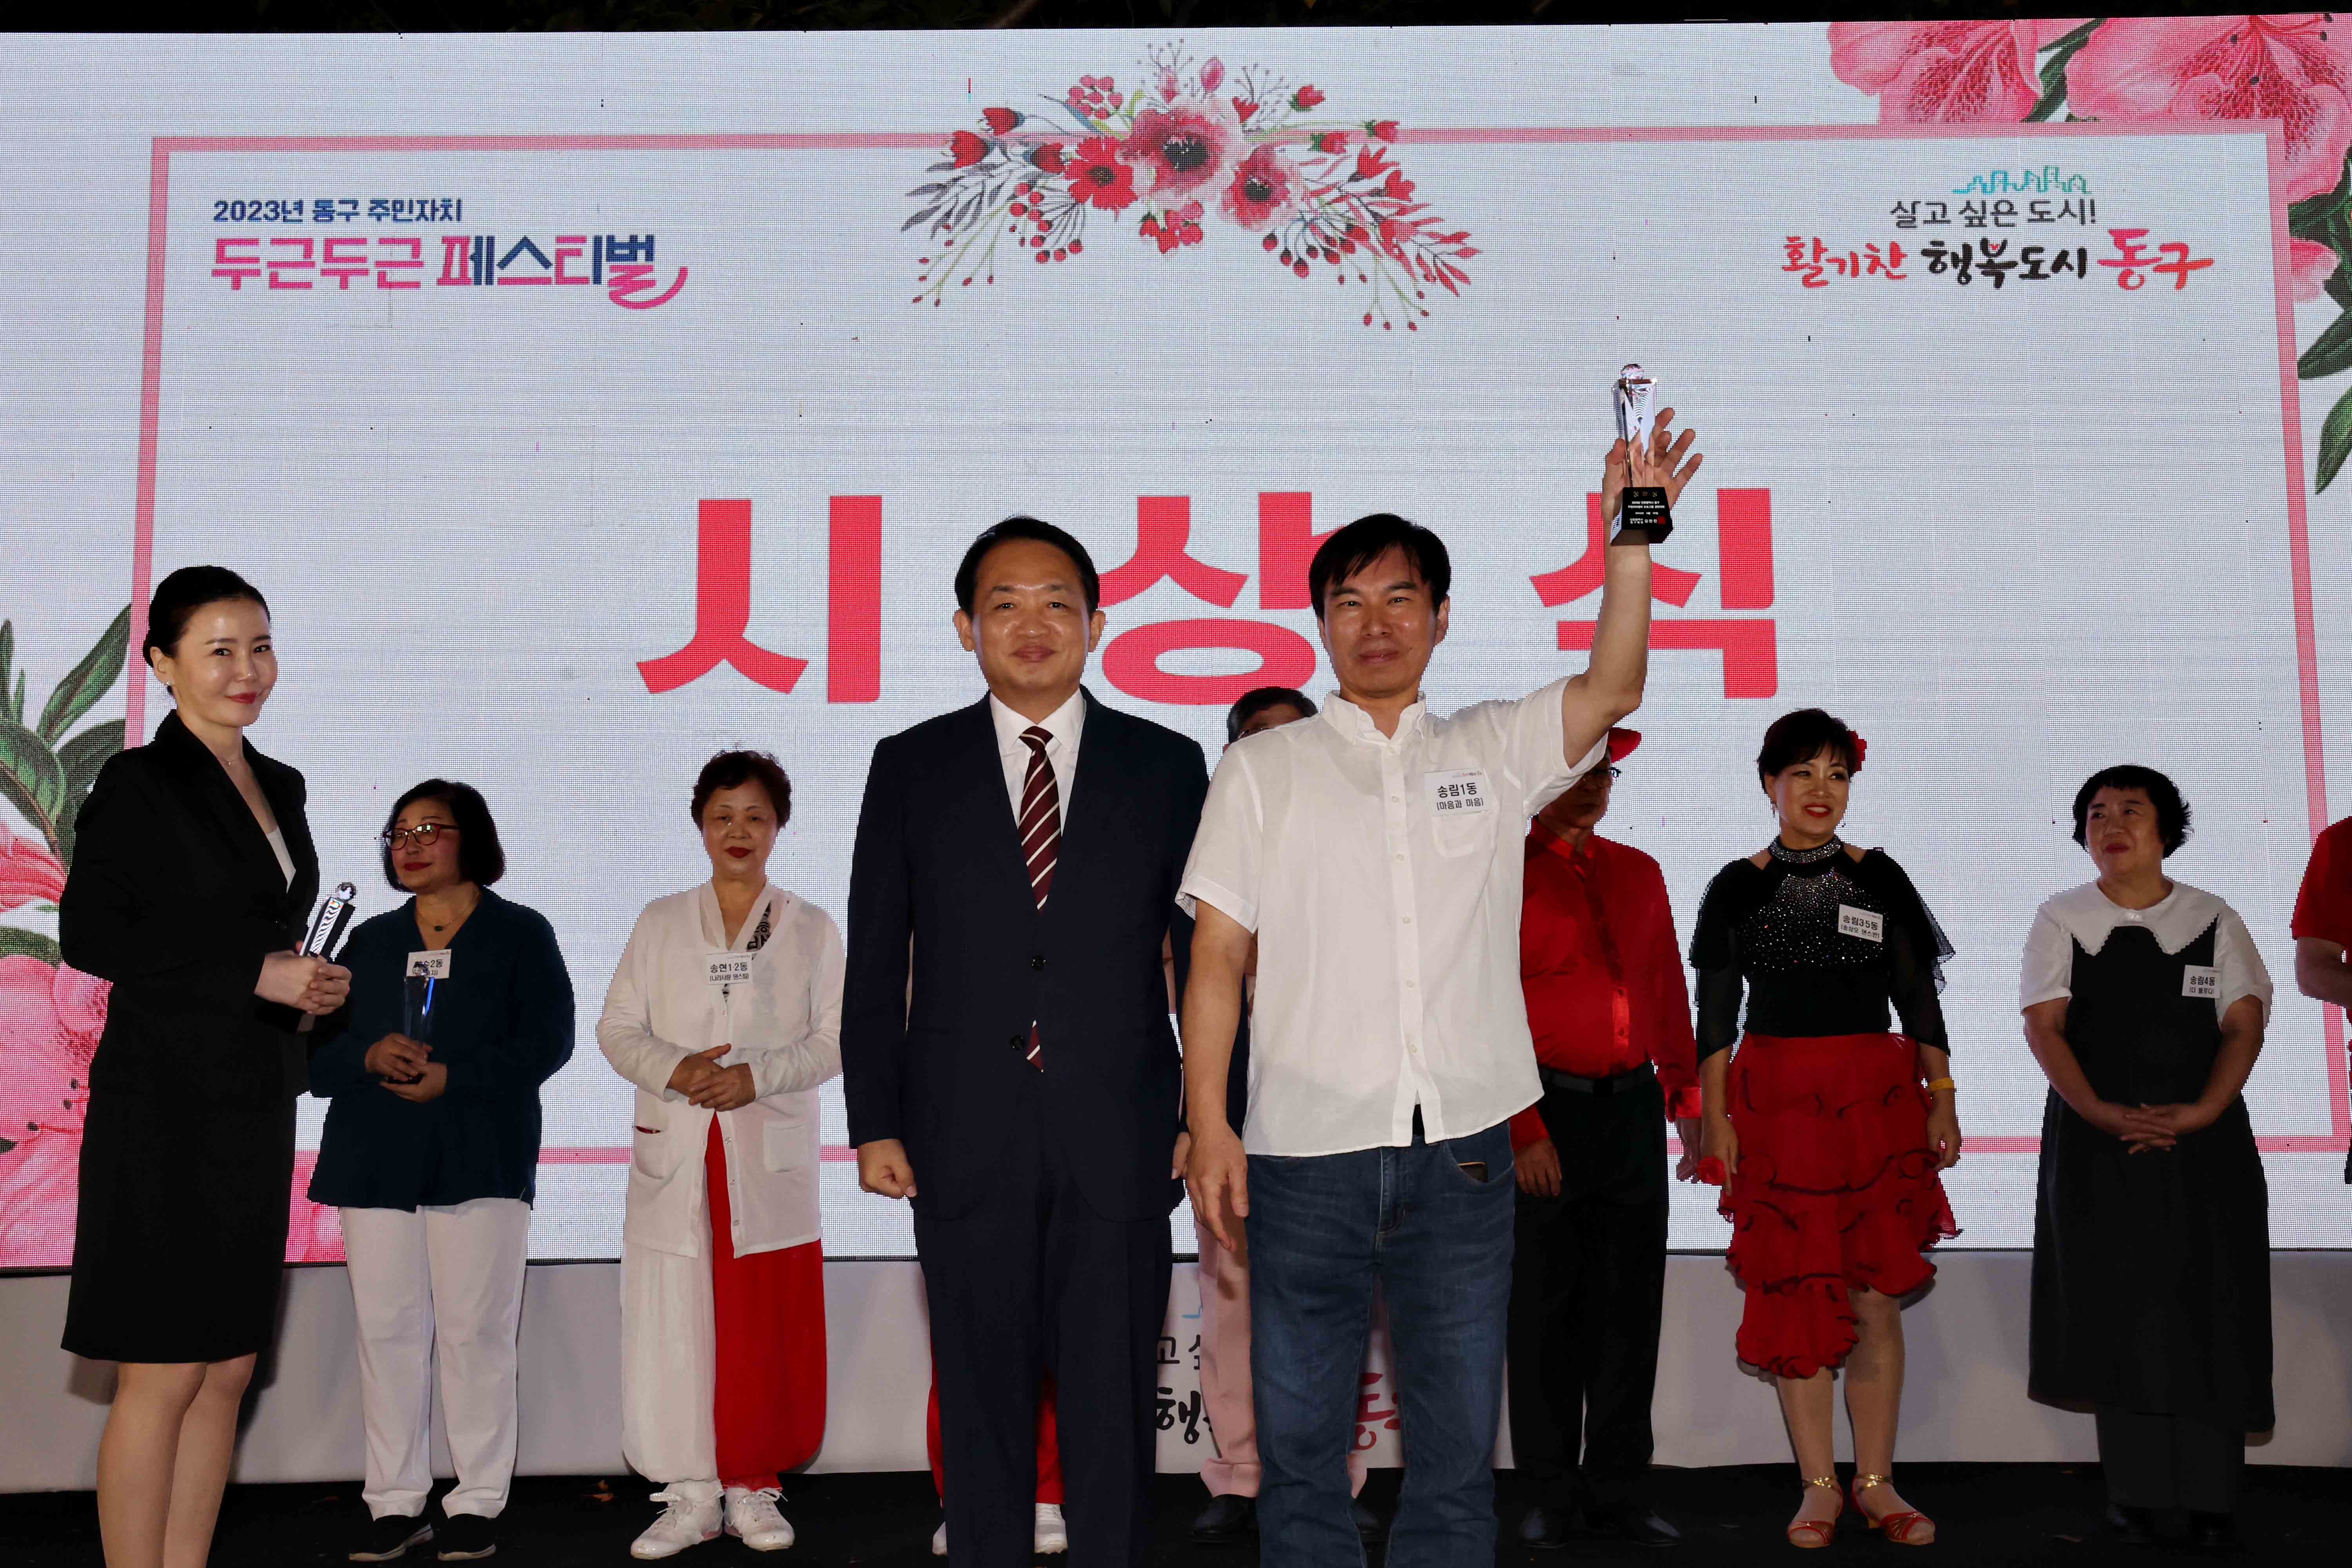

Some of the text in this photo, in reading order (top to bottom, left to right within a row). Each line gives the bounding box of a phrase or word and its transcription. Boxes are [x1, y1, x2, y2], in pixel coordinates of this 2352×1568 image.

[214, 199, 462, 222] 2023년 동구 주민자치
[1890, 198, 2096, 229] 살고 싶은 도시!
[211, 234, 688, 310] 두근두근 페스티벌
[1782, 228, 2214, 290] 활기찬 행복도시 동구
[1437, 782, 1477, 798] 송림1동
